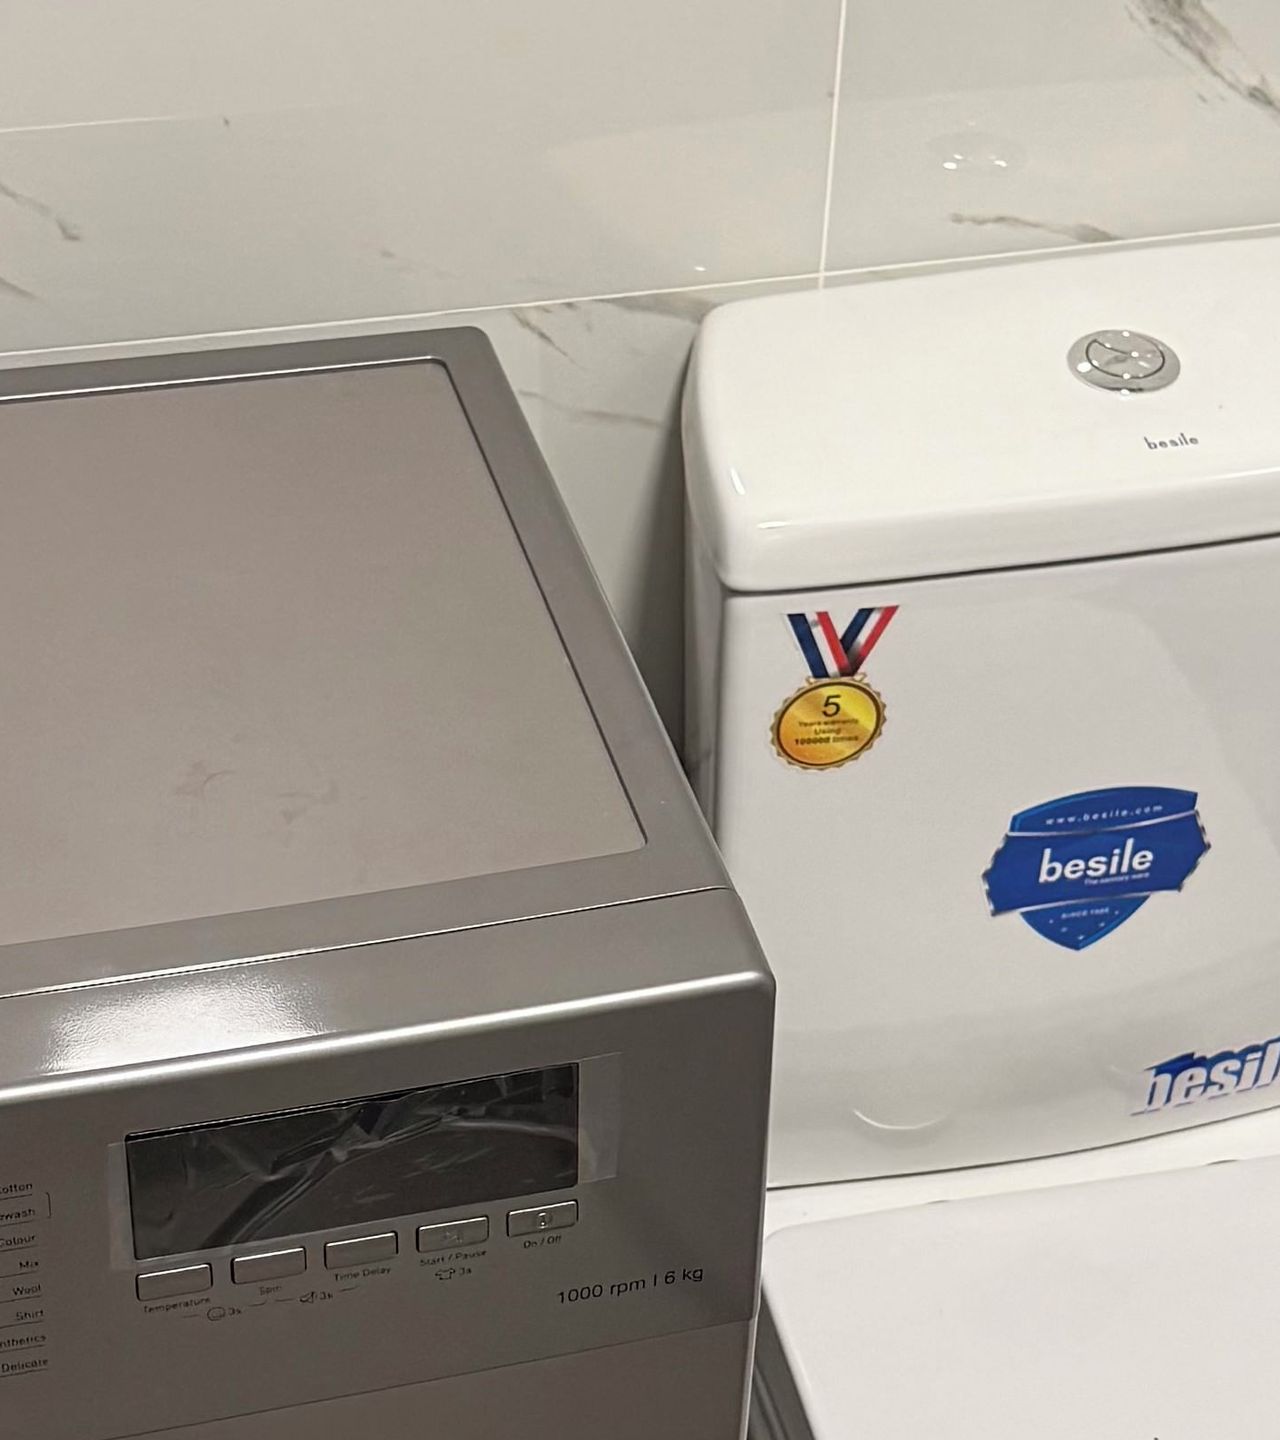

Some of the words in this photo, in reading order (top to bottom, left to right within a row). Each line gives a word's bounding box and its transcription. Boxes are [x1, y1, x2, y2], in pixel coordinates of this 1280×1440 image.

[1144, 432, 1199, 450] besile
[822, 694, 841, 717] 5
[1045, 805, 1163, 825] www.besile.com
[1038, 837, 1154, 884] besile
[523, 1239, 538, 1249] On
[547, 1234, 562, 1246] Off
[419, 1255, 445, 1267] Start
[455, 1248, 487, 1261] Pause
[334, 1270, 360, 1283] Time
[362, 1265, 392, 1278] Delay
[12, 1283, 42, 1296] Wool
[557, 1283, 604, 1305] 1000
[609, 1278, 646, 1300] rpm
[664, 1270, 676, 1286] 6
[681, 1264, 705, 1287] kg
[143, 1296, 211, 1315] Temperature
[15, 1309, 44, 1321] Shirt
[1, 1358, 49, 1374] Delicate
